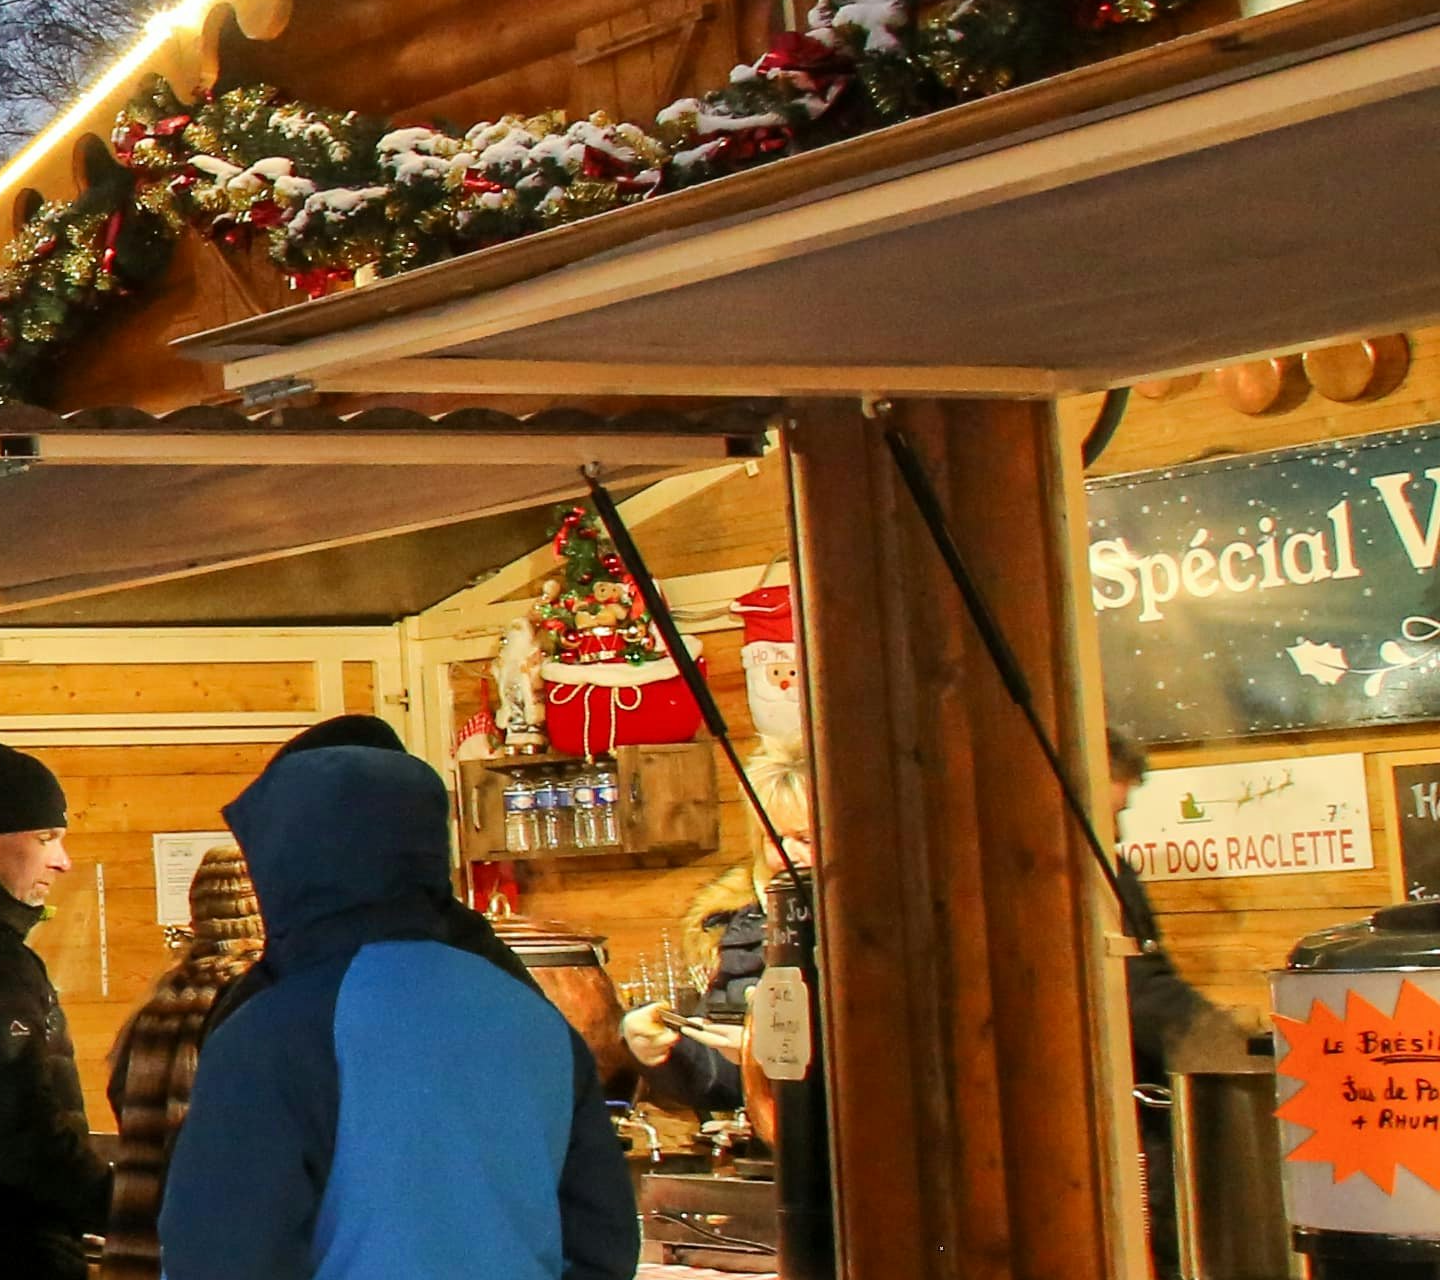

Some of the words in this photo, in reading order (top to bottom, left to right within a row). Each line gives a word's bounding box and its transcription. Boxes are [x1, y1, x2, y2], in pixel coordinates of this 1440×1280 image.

[1089, 500, 1362, 623] Spécial
[1165, 838, 1219, 874] DOG
[1226, 828, 1356, 870] RACLETTE
[1378, 1108, 1439, 1131] RHUM
